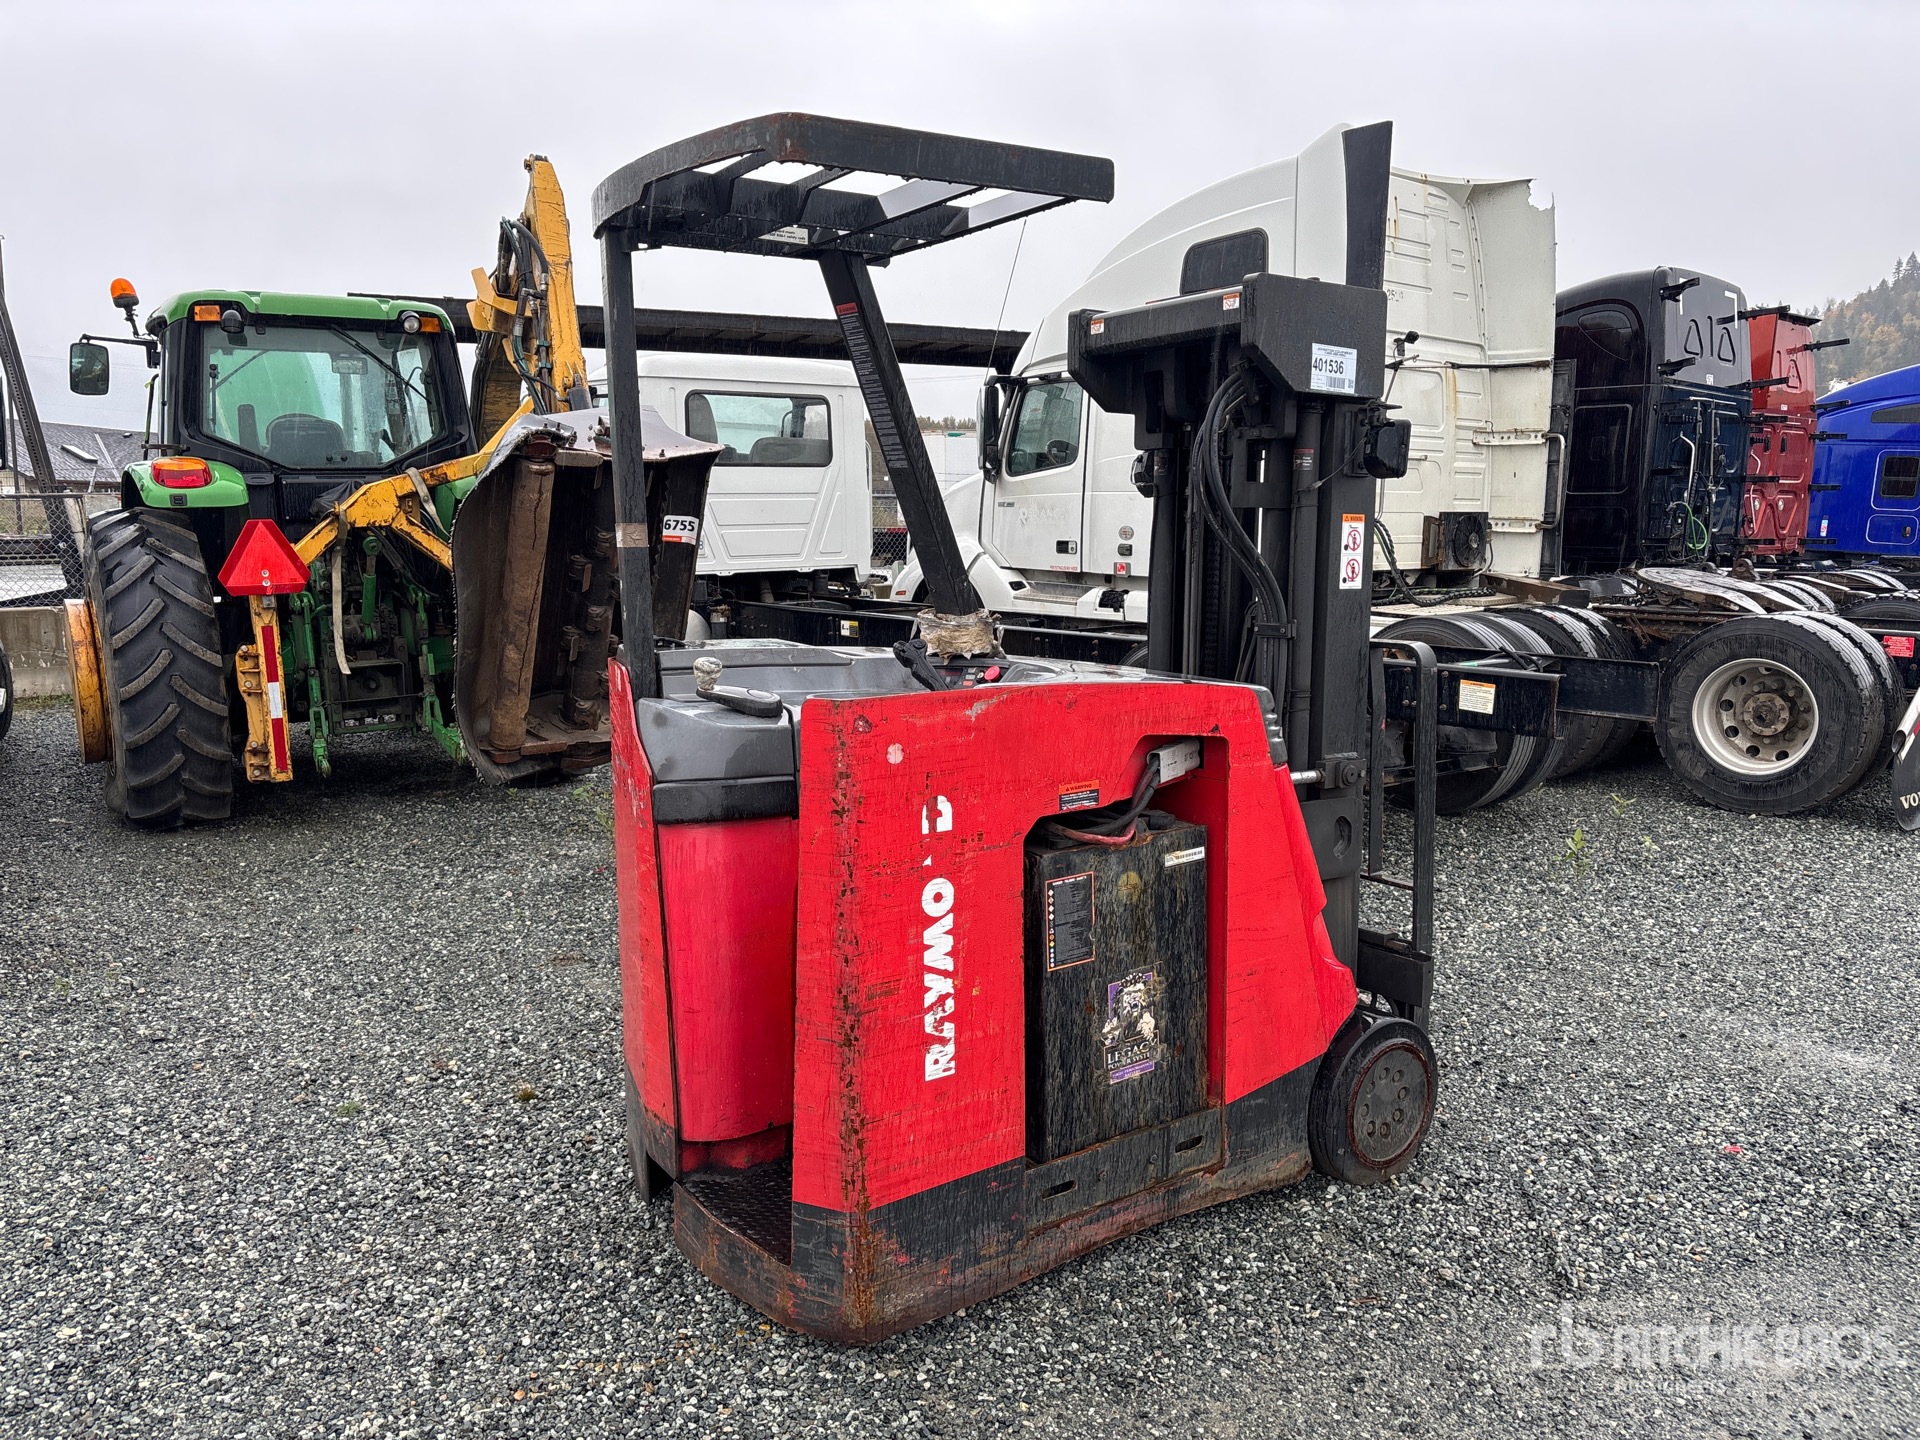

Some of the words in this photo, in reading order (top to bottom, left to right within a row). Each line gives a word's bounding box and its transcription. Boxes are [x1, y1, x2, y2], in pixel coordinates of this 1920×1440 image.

[1312, 357, 1344, 374] 401536
[664, 519, 696, 532] 6755
[1899, 791, 1920, 809] VO
[921, 795, 955, 1082] RAYMOD
